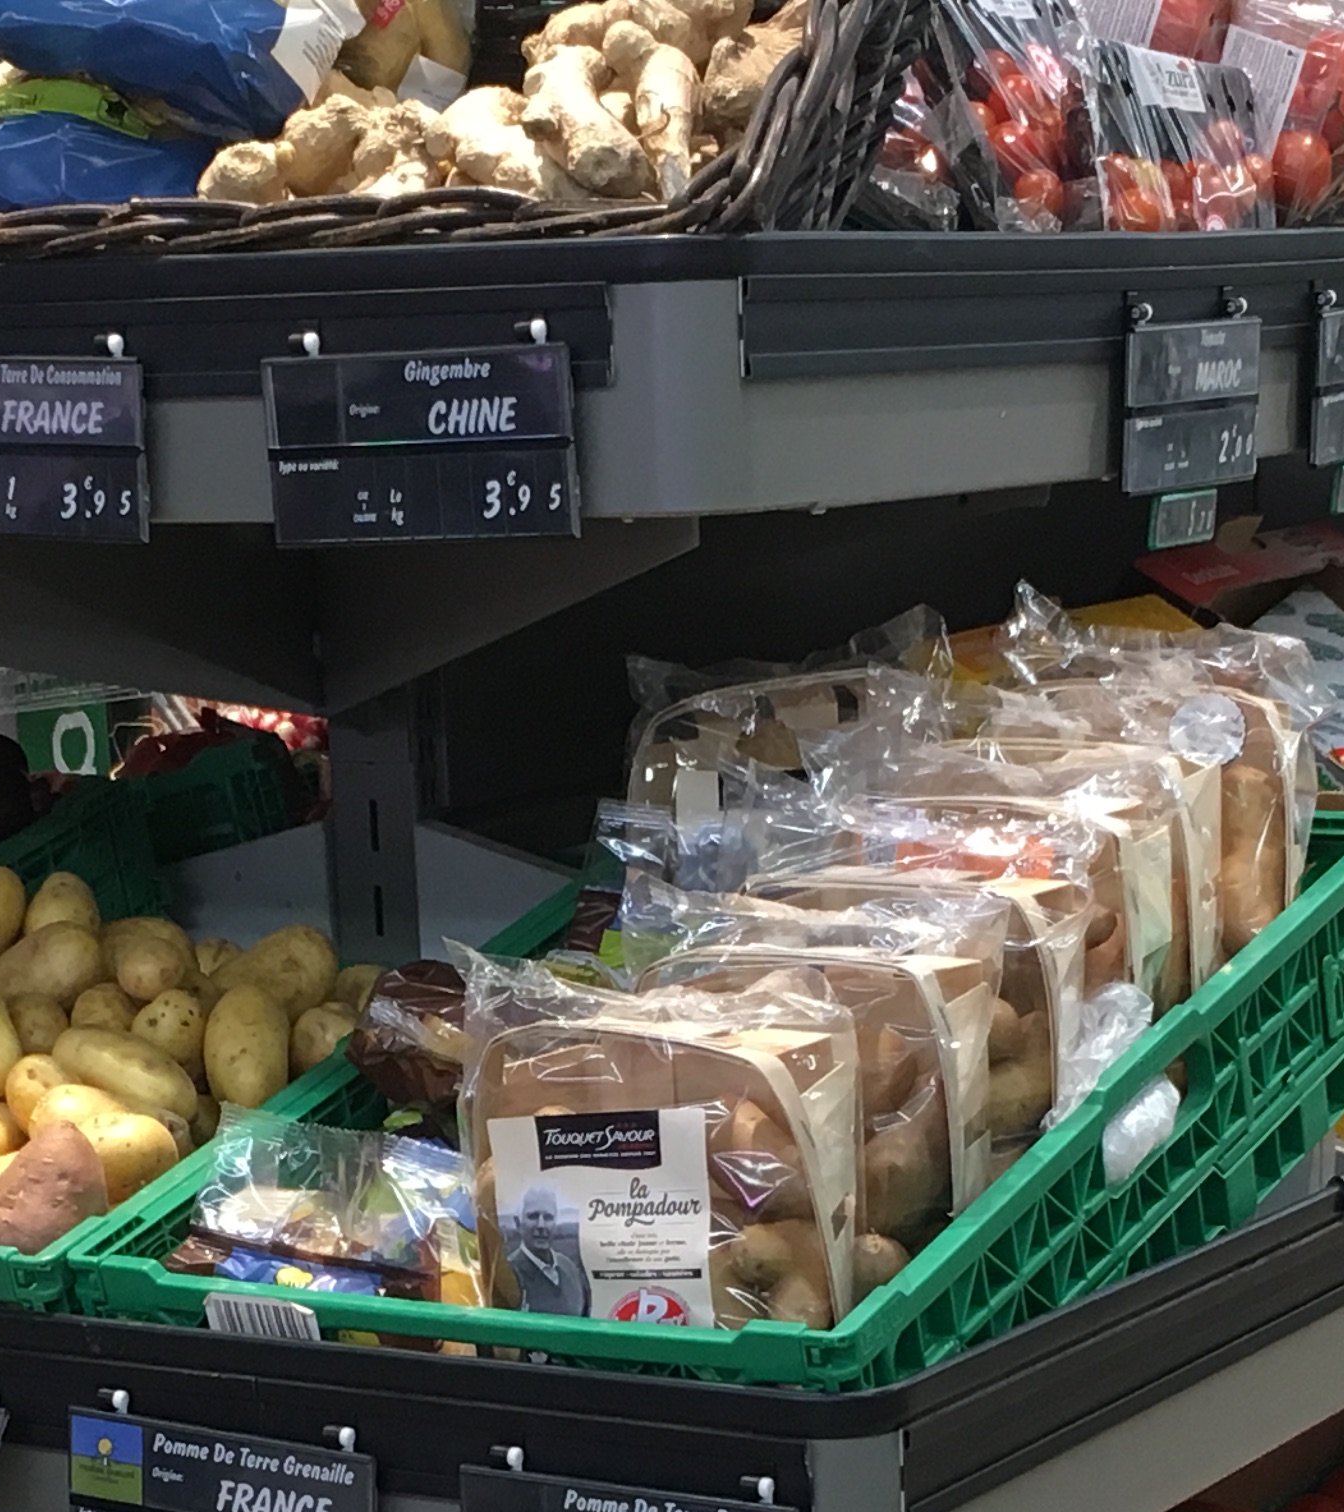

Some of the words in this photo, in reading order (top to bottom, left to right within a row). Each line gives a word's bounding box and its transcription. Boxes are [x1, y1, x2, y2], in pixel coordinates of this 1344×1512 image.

[0, 364, 28, 384] Terre
[30, 364, 45, 385] De
[46, 365, 122, 386] Consommation
[404, 358, 491, 387] Gingembre
[1194, 359, 1243, 392] MAROC
[1, 400, 104, 435] FRANCE
[428, 396, 518, 436] CHINE
[543, 1128, 605, 1147] TOUQUET
[596, 1125, 655, 1151] SAVOUR
[629, 1176, 650, 1199] la
[588, 1192, 702, 1228] Pompadour
[153, 1433, 209, 1461] Pomme
[214, 1443, 235, 1465] De
[239, 1447, 279, 1473] Terre
[283, 1455, 354, 1486] Grenaille
